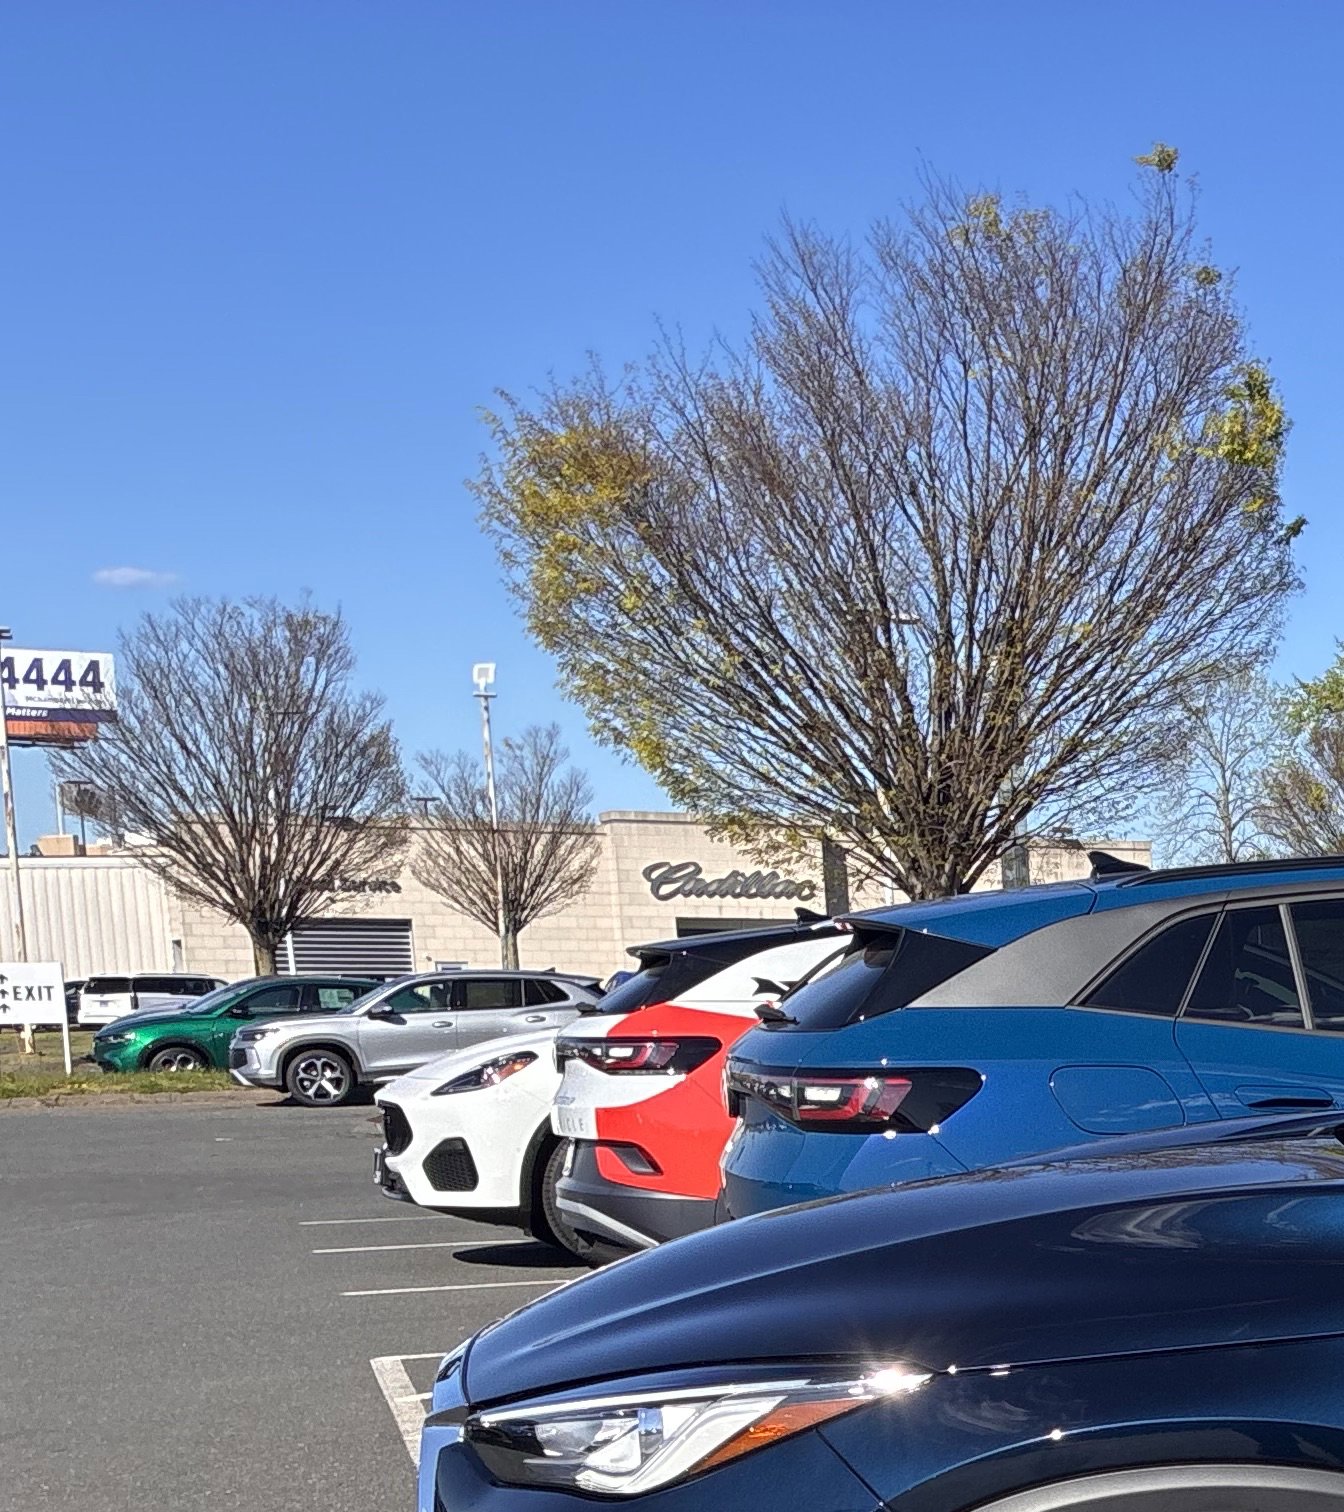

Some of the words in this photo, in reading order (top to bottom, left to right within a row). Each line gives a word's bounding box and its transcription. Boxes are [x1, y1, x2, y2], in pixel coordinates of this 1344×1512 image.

[1, 656, 105, 693] 4444
[642, 861, 816, 901] Cadillac
[13, 985, 54, 1001] EXIT
